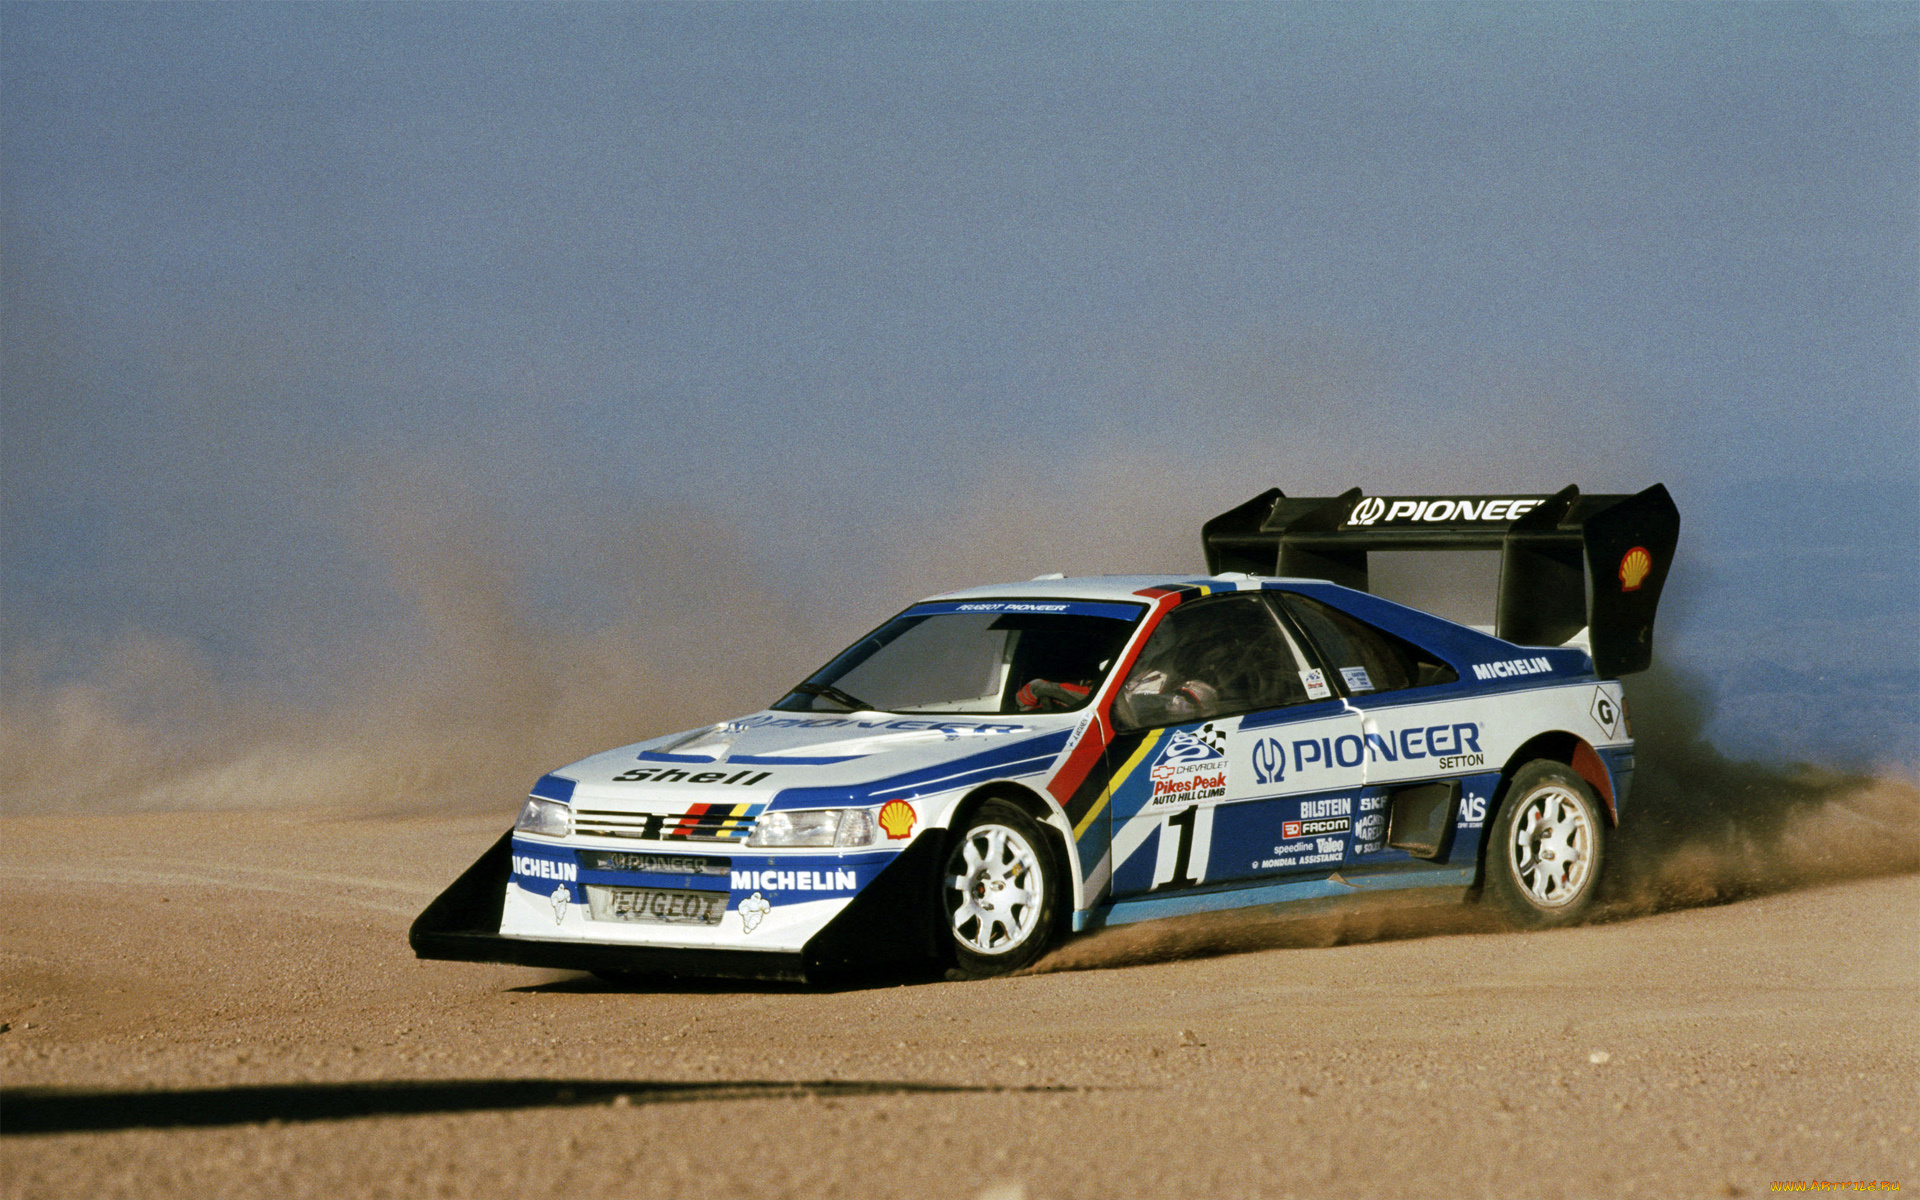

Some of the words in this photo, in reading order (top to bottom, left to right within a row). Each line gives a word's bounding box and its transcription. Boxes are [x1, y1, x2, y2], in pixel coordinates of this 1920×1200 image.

[1385, 500, 1546, 521] PIONEE
[1472, 656, 1553, 680] MICHELIN
[1598, 699, 1614, 725] G
[1292, 722, 1483, 772] PIONEER
[1176, 761, 1228, 775] CHEVROLET
[1439, 753, 1484, 770] SETTON
[612, 768, 774, 786] Shell
[1154, 779, 1192, 796] Pikes
[1192, 772, 1227, 790] Peak
[1152, 794, 1177, 805] AUTO
[1177, 791, 1196, 802] HILL
[1197, 787, 1226, 799] CLIMB
[1300, 798, 1351, 819] BILSTEIN
[1302, 819, 1348, 834] FACOM
[1149, 804, 1198, 892] 1
[1273, 841, 1313, 855] speedline
[1316, 837, 1344, 854] Valeo
[1261, 857, 1297, 869] MONDIAL
[1299, 852, 1343, 865] ASSISTANCE
[731, 870, 857, 890] MICHELIN
